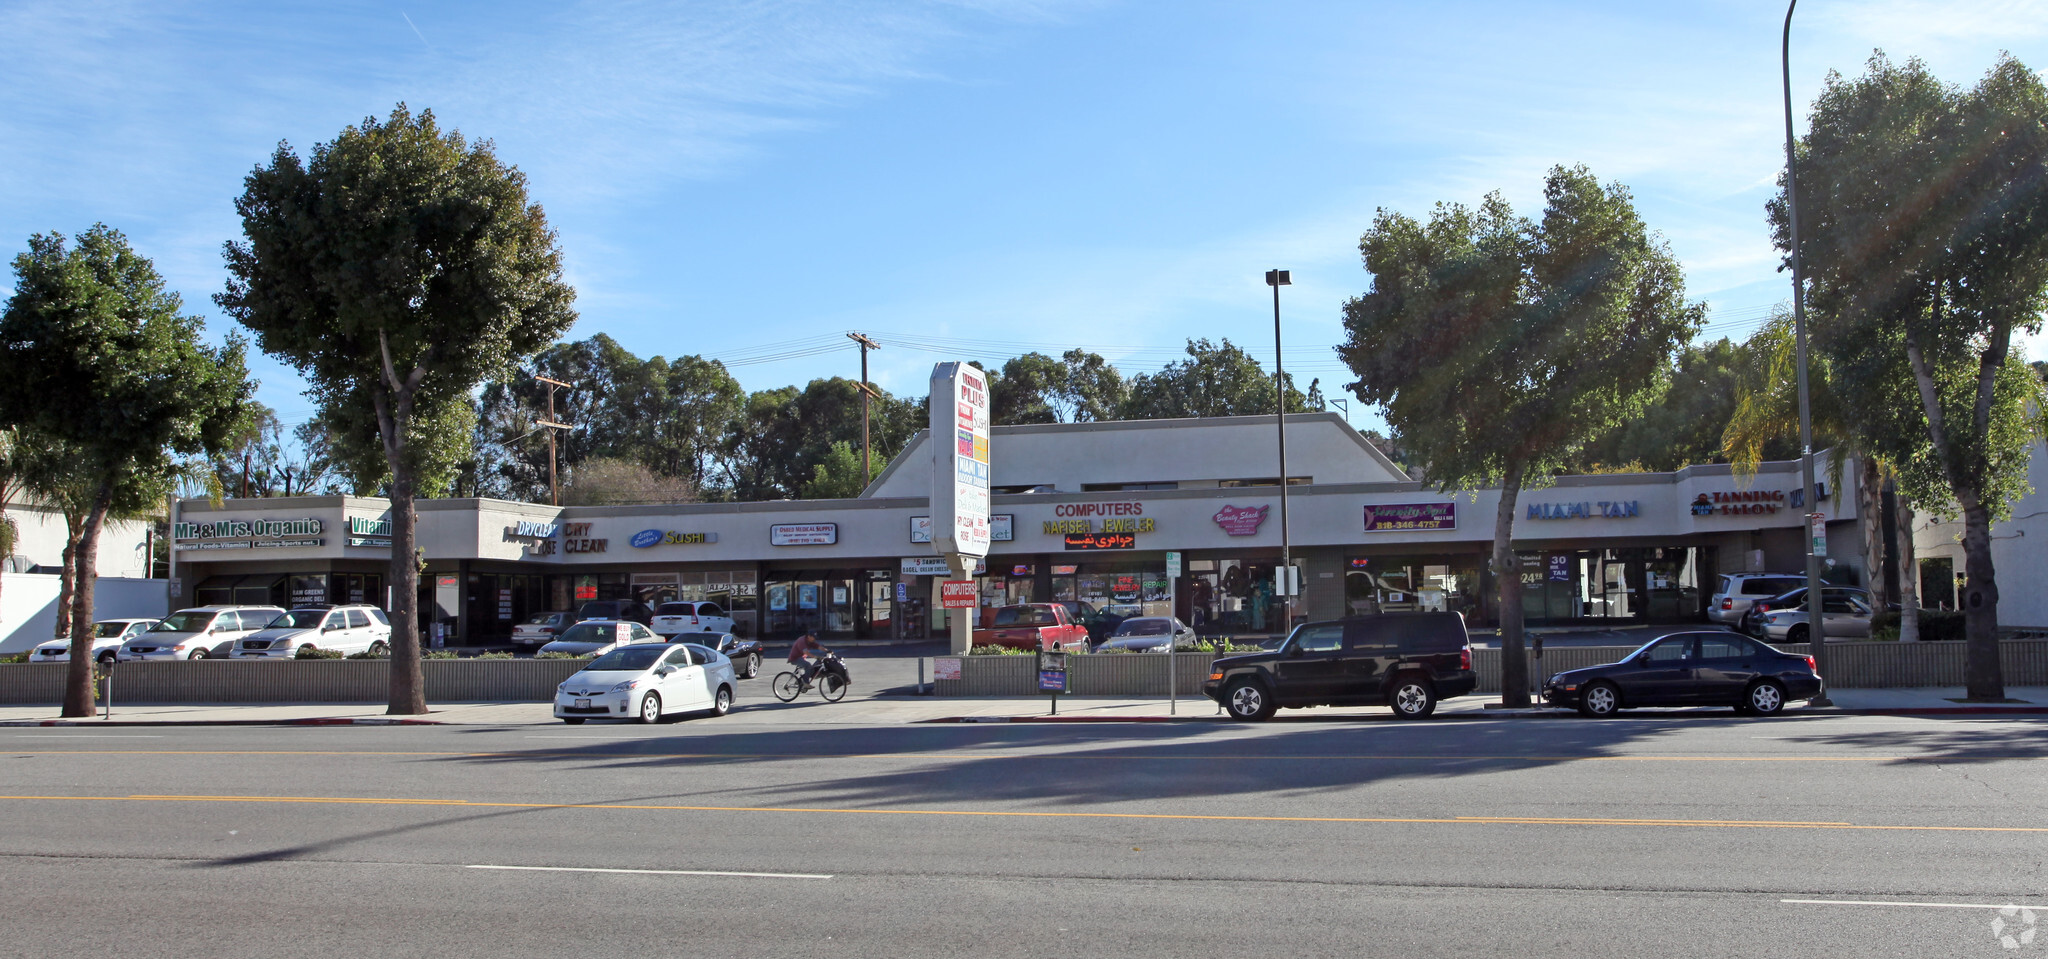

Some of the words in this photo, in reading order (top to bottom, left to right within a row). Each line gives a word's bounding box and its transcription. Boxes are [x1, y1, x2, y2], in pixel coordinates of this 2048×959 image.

[961, 385, 985, 408] PLUS
[1712, 491, 1785, 502] TANNING
[1055, 502, 1143, 517] COMPUTERS
[1371, 506, 1420, 517] Serenity
[1423, 505, 1447, 517] Spa
[1526, 501, 1590, 520] MIAMI
[1597, 500, 1639, 518] TAN
[1721, 503, 1776, 516] SALON
[1216, 513, 1238, 523] Beauty
[1239, 511, 1259, 520] Shack
[174, 522, 199, 539] Mr.
[200, 524, 213, 539] &
[215, 520, 251, 537] Mrs.
[253, 518, 320, 537] Organic
[352, 516, 391, 535] Vitami
[565, 523, 592, 537] DRY
[1043, 520, 1091, 535] NAFISEH
[1100, 518, 1154, 533] JEWELER
[1376, 521, 1440, 530] 818-346-4757
[565, 538, 608, 553] CLEAN
[1065, 533, 1095, 548] نفیسه
[1095, 534, 1134, 548] جواهری
[922, 558, 946, 566] SANDWIC
[1551, 556, 1566, 564] 30
[944, 583, 975, 595] COMPUTERS
[618, 633, 629, 641] GOLD
